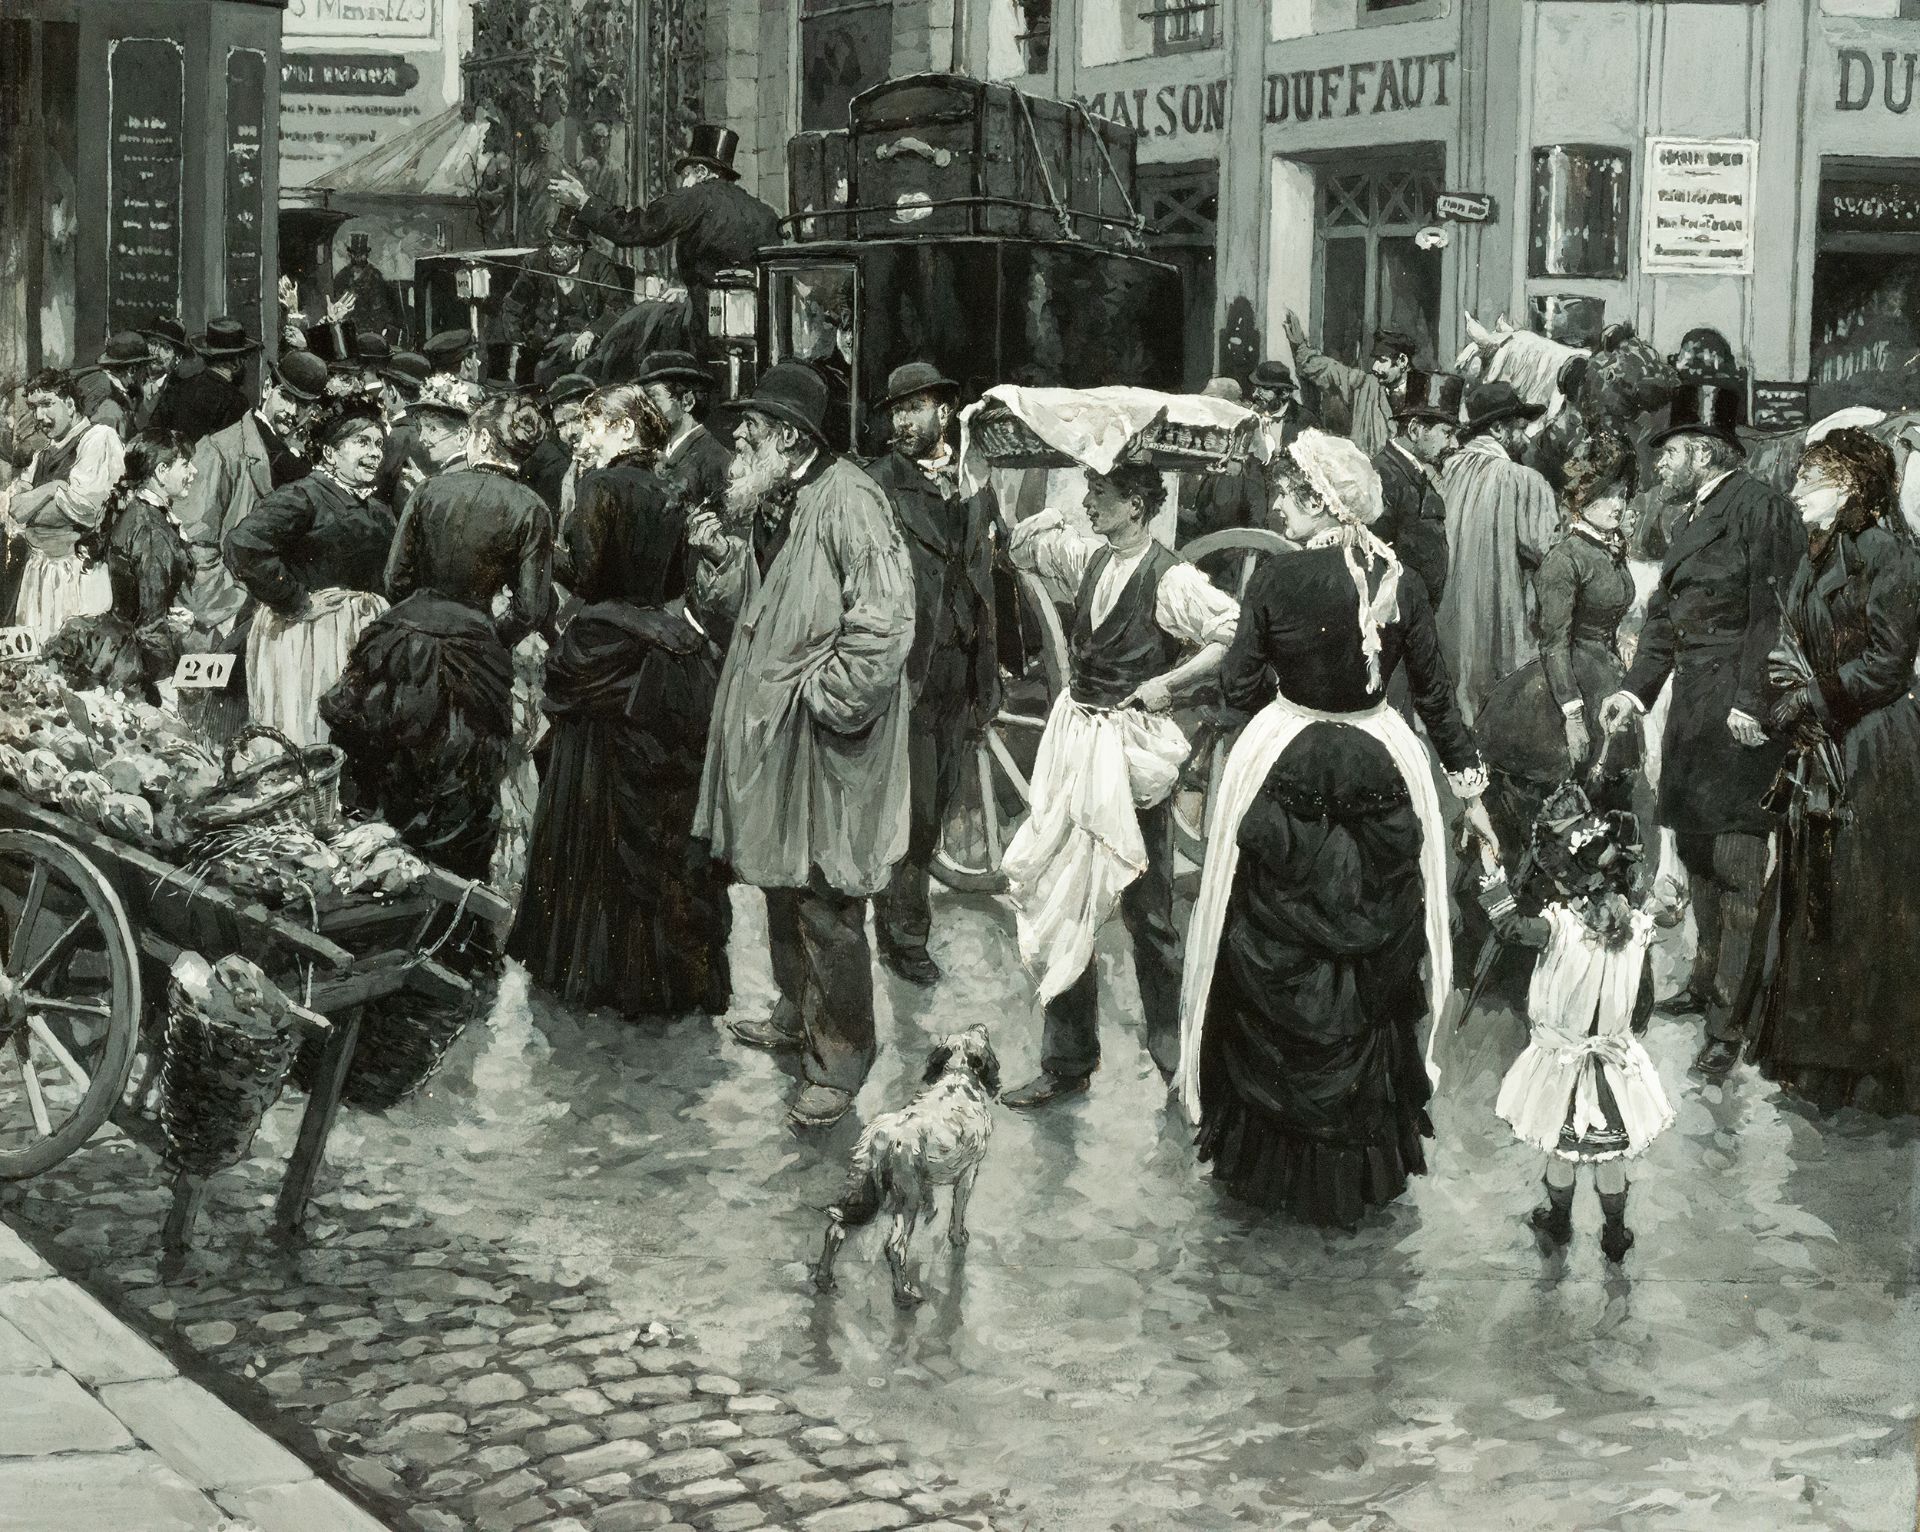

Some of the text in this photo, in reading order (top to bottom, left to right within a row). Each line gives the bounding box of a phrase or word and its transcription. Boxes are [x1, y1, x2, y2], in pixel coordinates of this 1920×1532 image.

[1263, 51, 1456, 123] DUFFAUT
[1835, 49, 1918, 114] DU
[184, 660, 223, 680] 20
